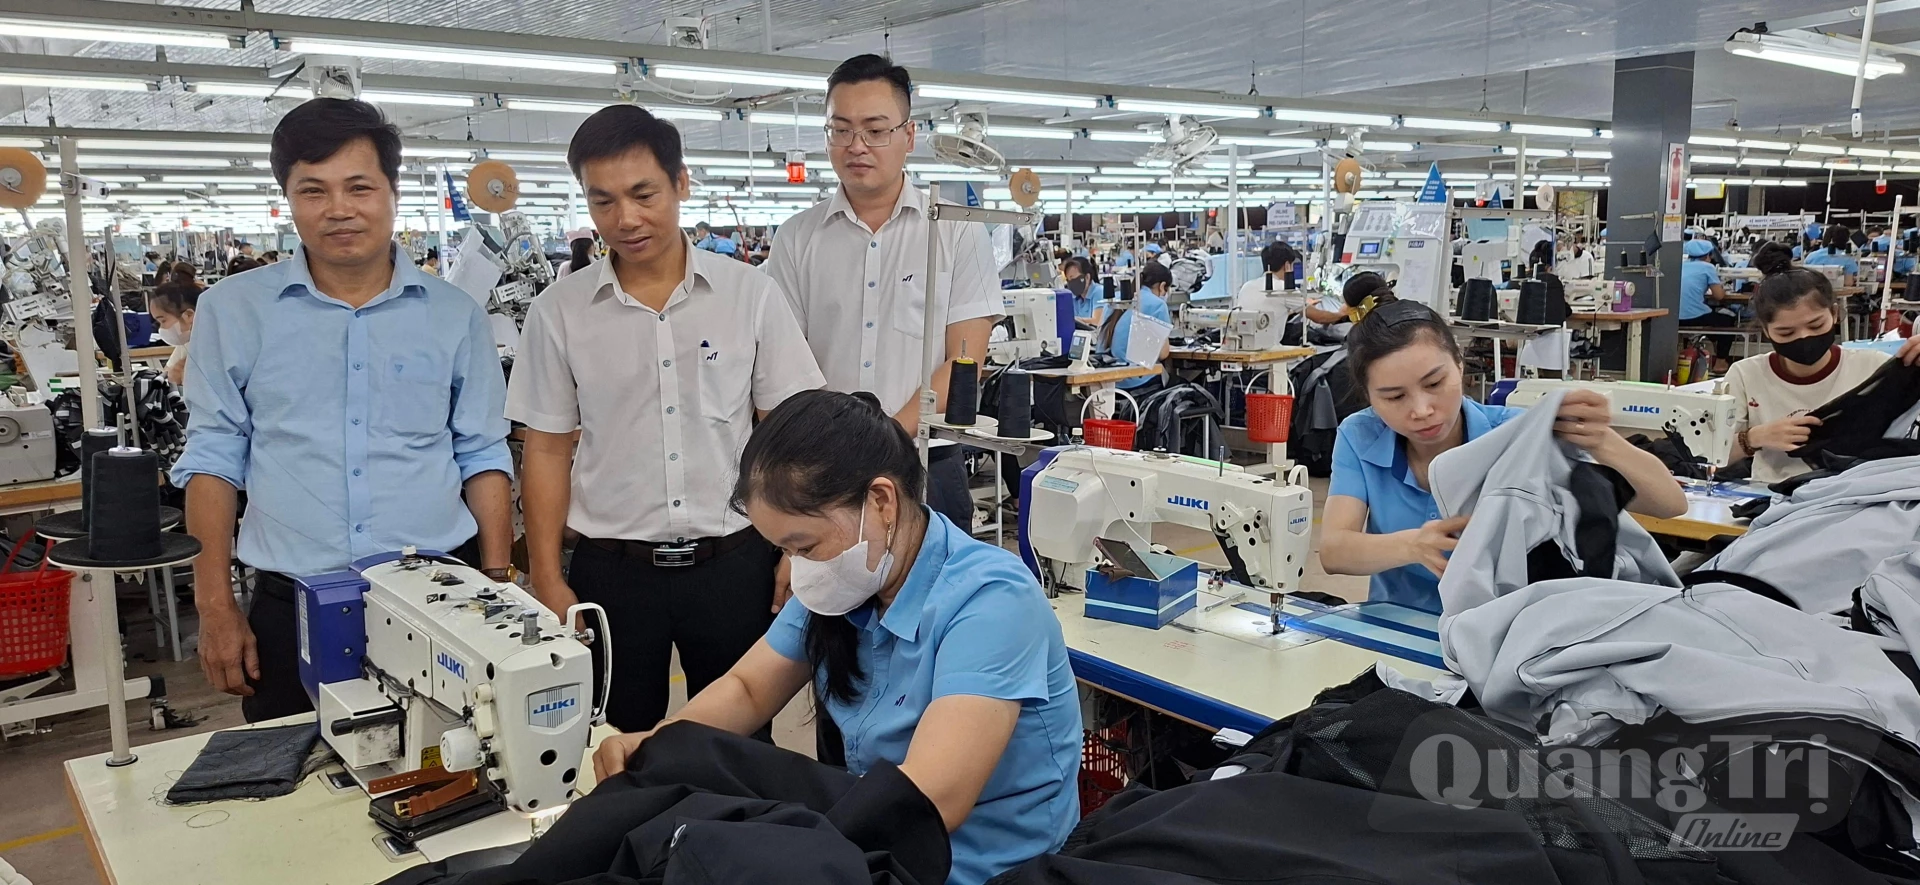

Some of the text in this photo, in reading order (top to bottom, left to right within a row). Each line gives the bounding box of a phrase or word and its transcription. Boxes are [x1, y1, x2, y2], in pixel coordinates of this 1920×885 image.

[1622, 405, 1660, 414] JUKI
[1167, 495, 1209, 511] JUKI
[1290, 516, 1307, 525] JUKI
[437, 652, 465, 680] JUKI
[533, 698, 575, 715] JUKI
